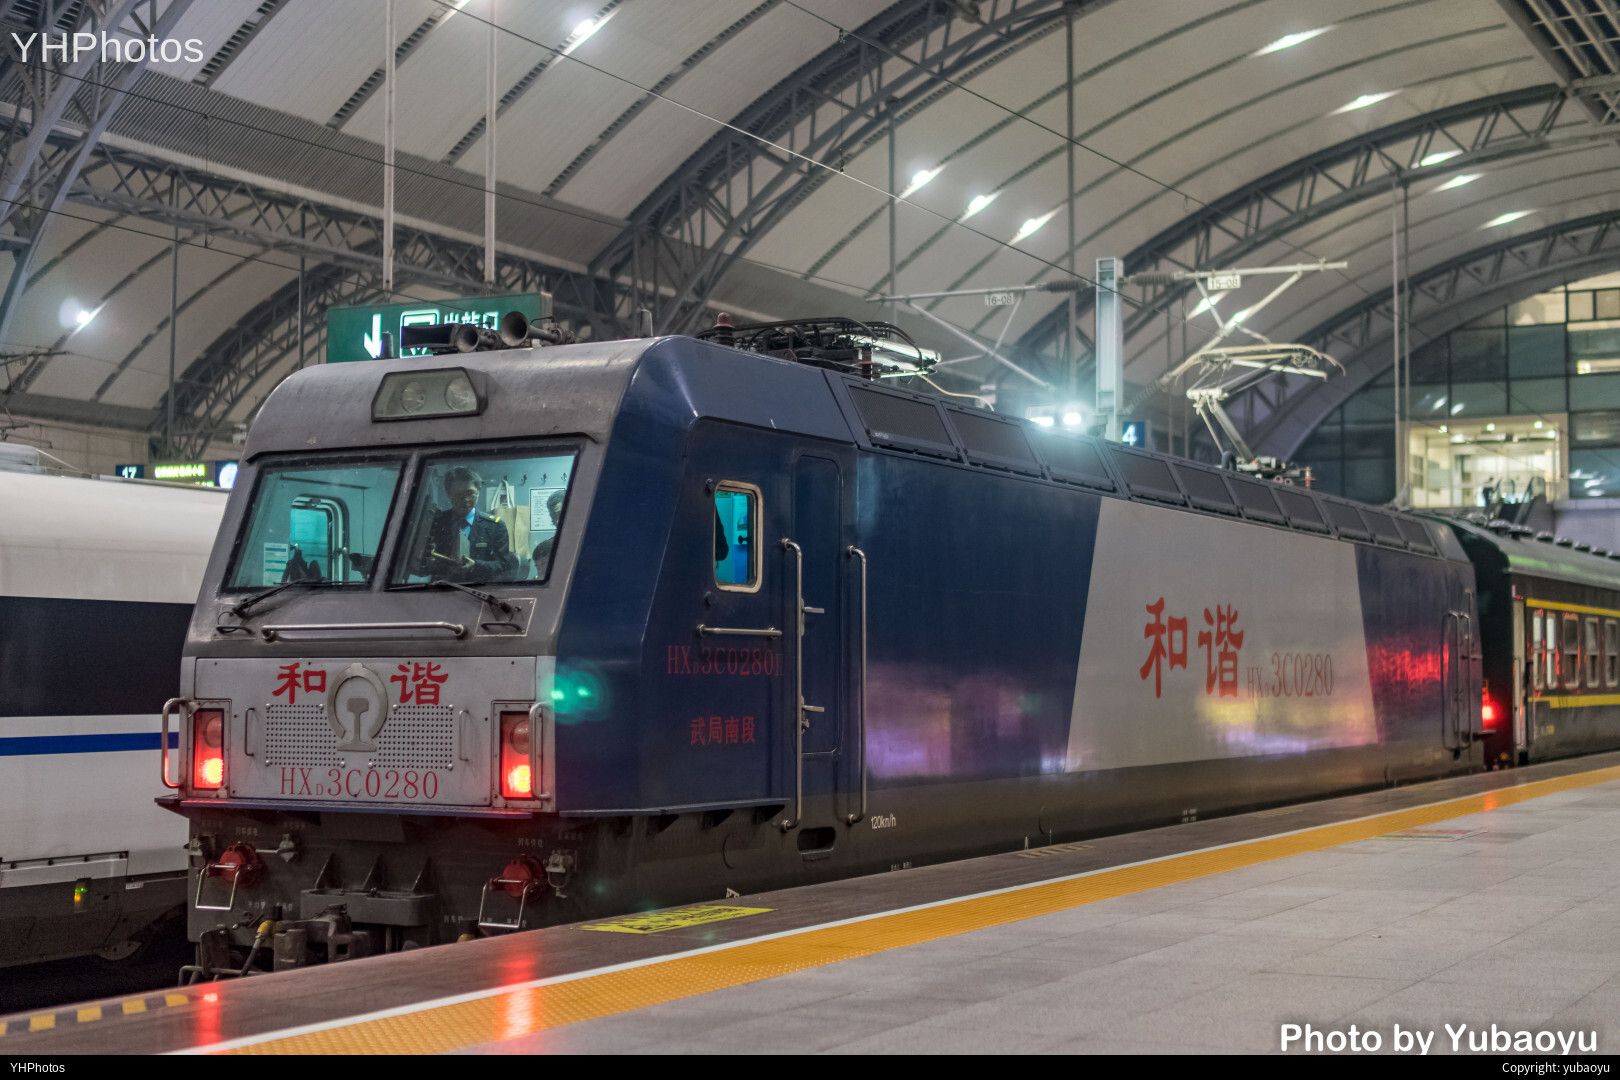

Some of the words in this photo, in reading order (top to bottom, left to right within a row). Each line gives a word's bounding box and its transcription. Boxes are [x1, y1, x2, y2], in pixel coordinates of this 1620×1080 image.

[1209, 278, 1238, 289] 15-08
[1122, 425, 1136, 446] 4
[121, 466, 137, 479] 17
[1140, 597, 1244, 699] 和谐
[690, 716, 756, 745] 武局南段
[870, 813, 897, 829] 120km/h
